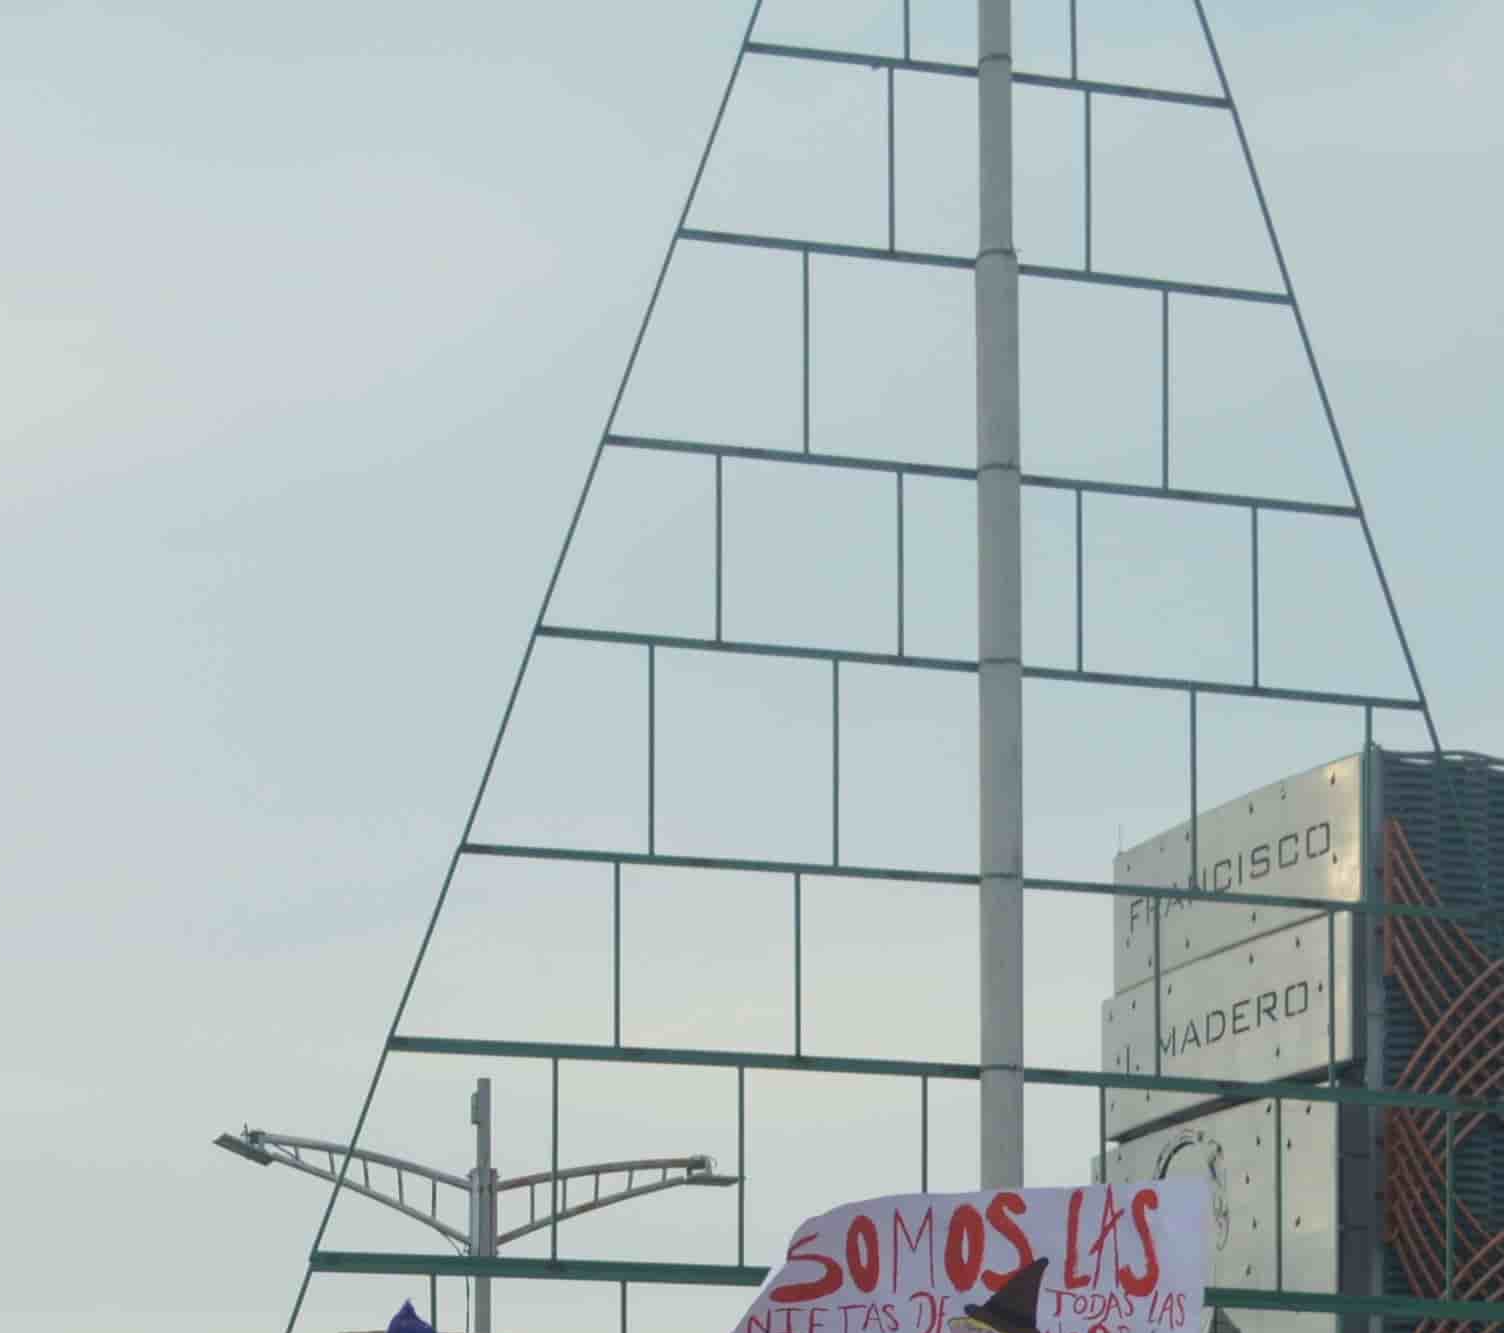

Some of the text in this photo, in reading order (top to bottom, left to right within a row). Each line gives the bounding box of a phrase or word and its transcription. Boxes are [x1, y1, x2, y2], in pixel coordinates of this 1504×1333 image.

[769, 1184, 1160, 1304] SOMOS LAS
[1044, 1288, 1185, 1327] TODAS LAS
